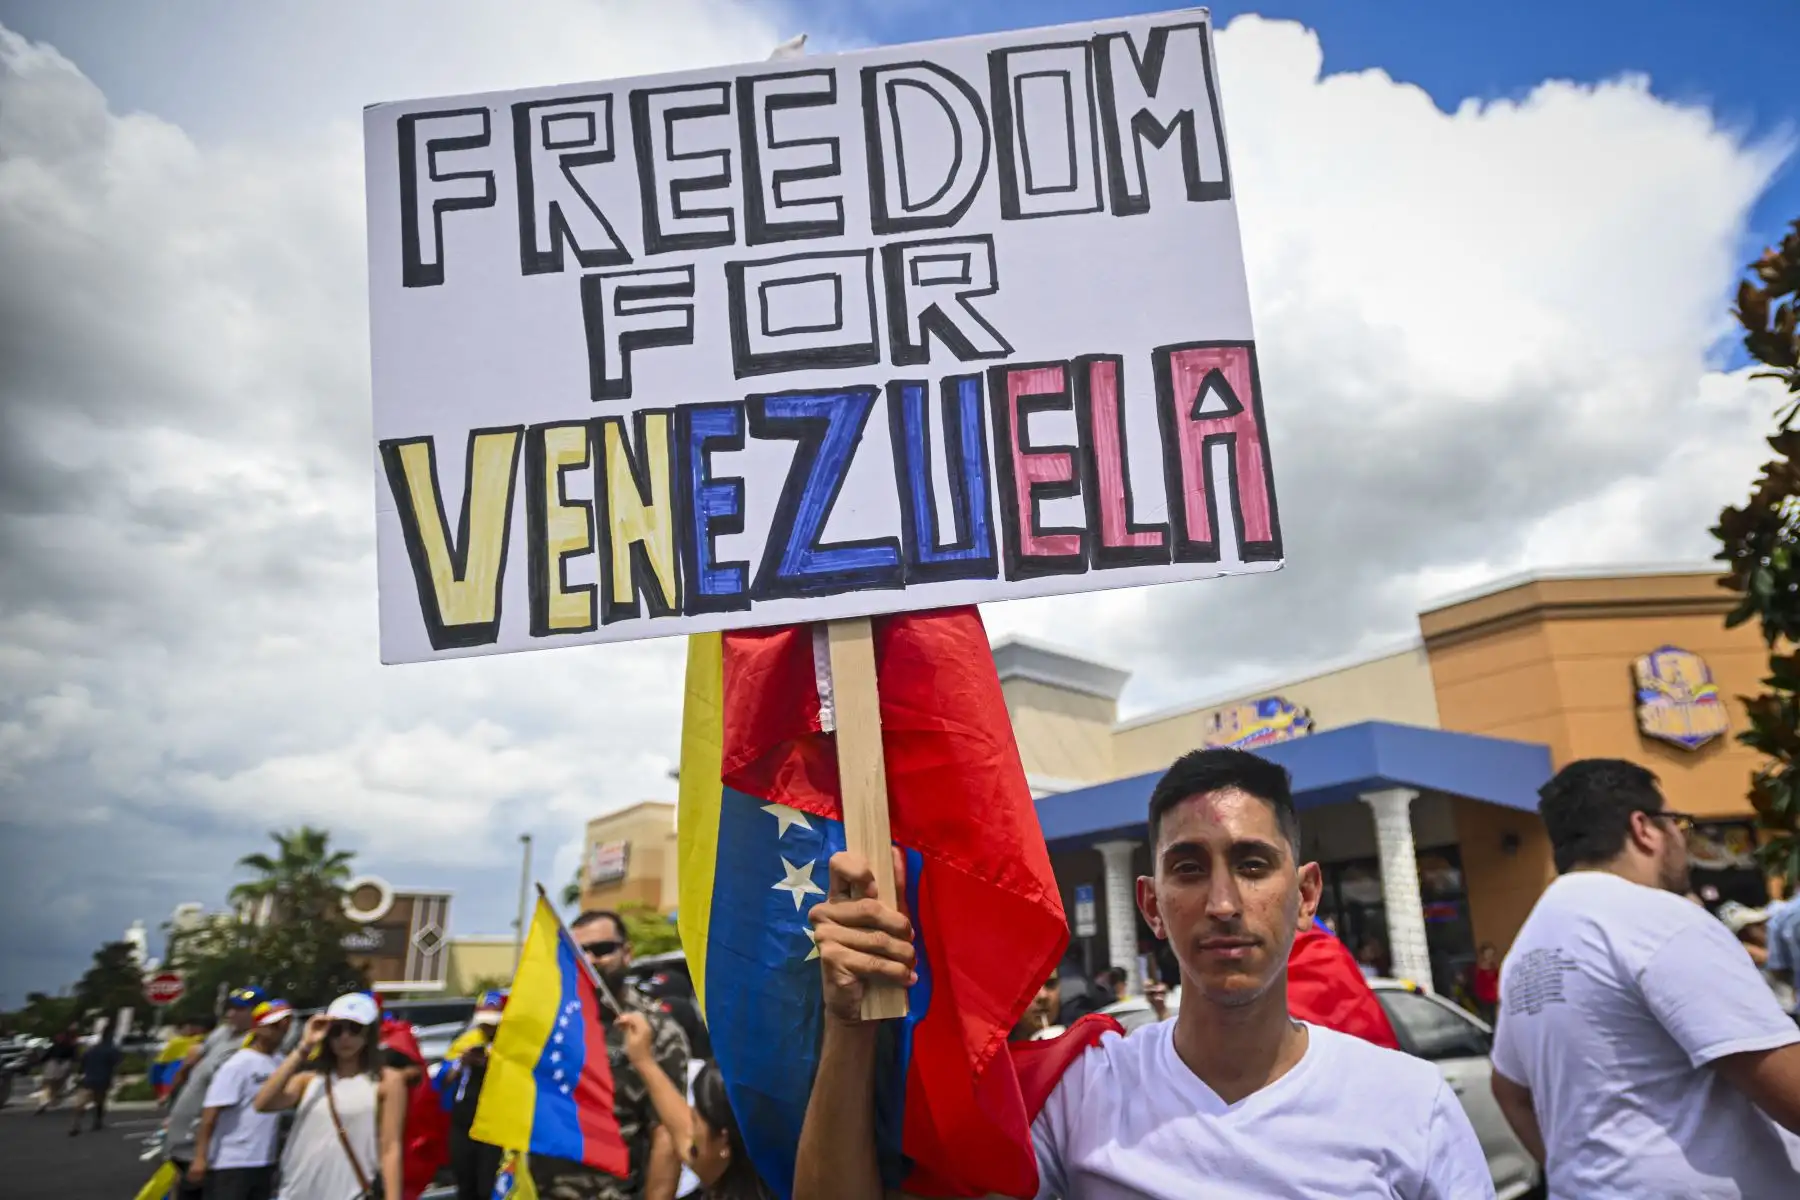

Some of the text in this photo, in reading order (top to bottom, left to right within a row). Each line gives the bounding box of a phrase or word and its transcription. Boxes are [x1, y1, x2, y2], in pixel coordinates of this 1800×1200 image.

[397, 23, 1232, 288] FREEDOM
[581, 233, 1015, 402] FOR
[379, 340, 1284, 651] VENEZUELA
[147, 980, 184, 996] STOP
